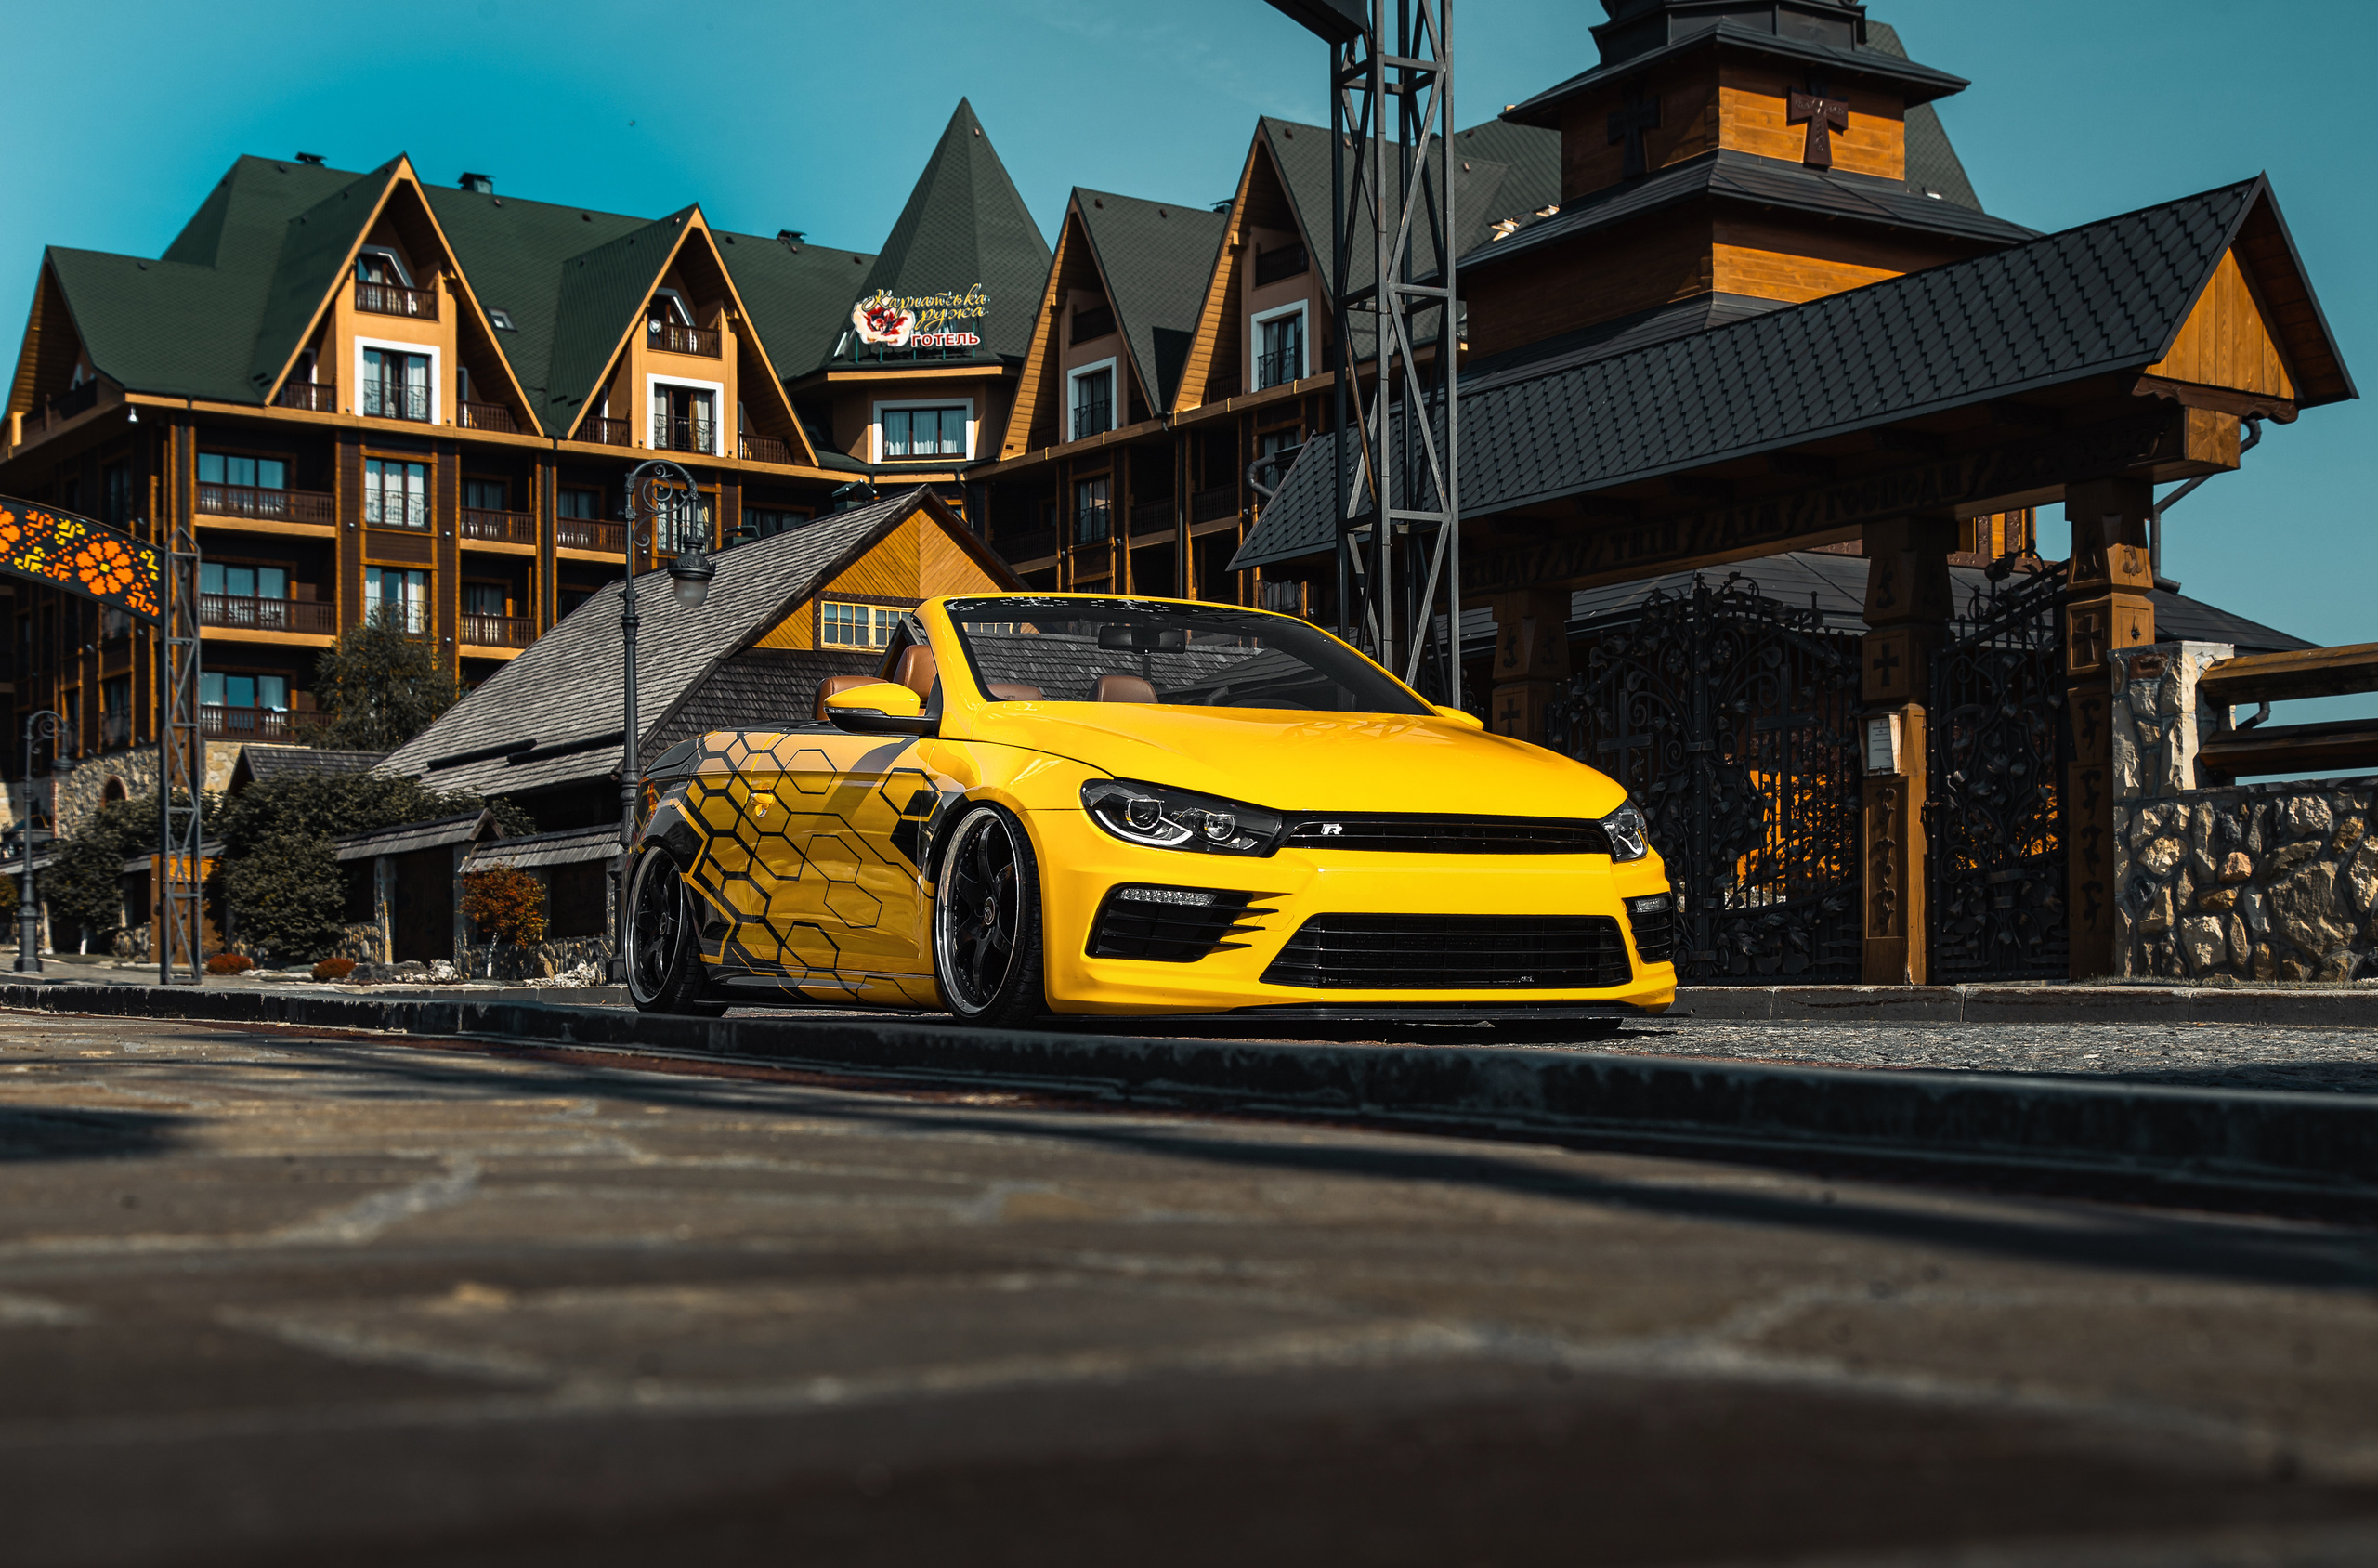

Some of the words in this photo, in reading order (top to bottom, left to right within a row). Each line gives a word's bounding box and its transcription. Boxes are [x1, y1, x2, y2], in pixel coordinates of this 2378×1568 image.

[861, 282, 988, 319] Карпатська
[914, 305, 986, 333] ружа
[910, 332, 980, 346] ГОТЕЛЬ
[1321, 823, 1343, 835] R
